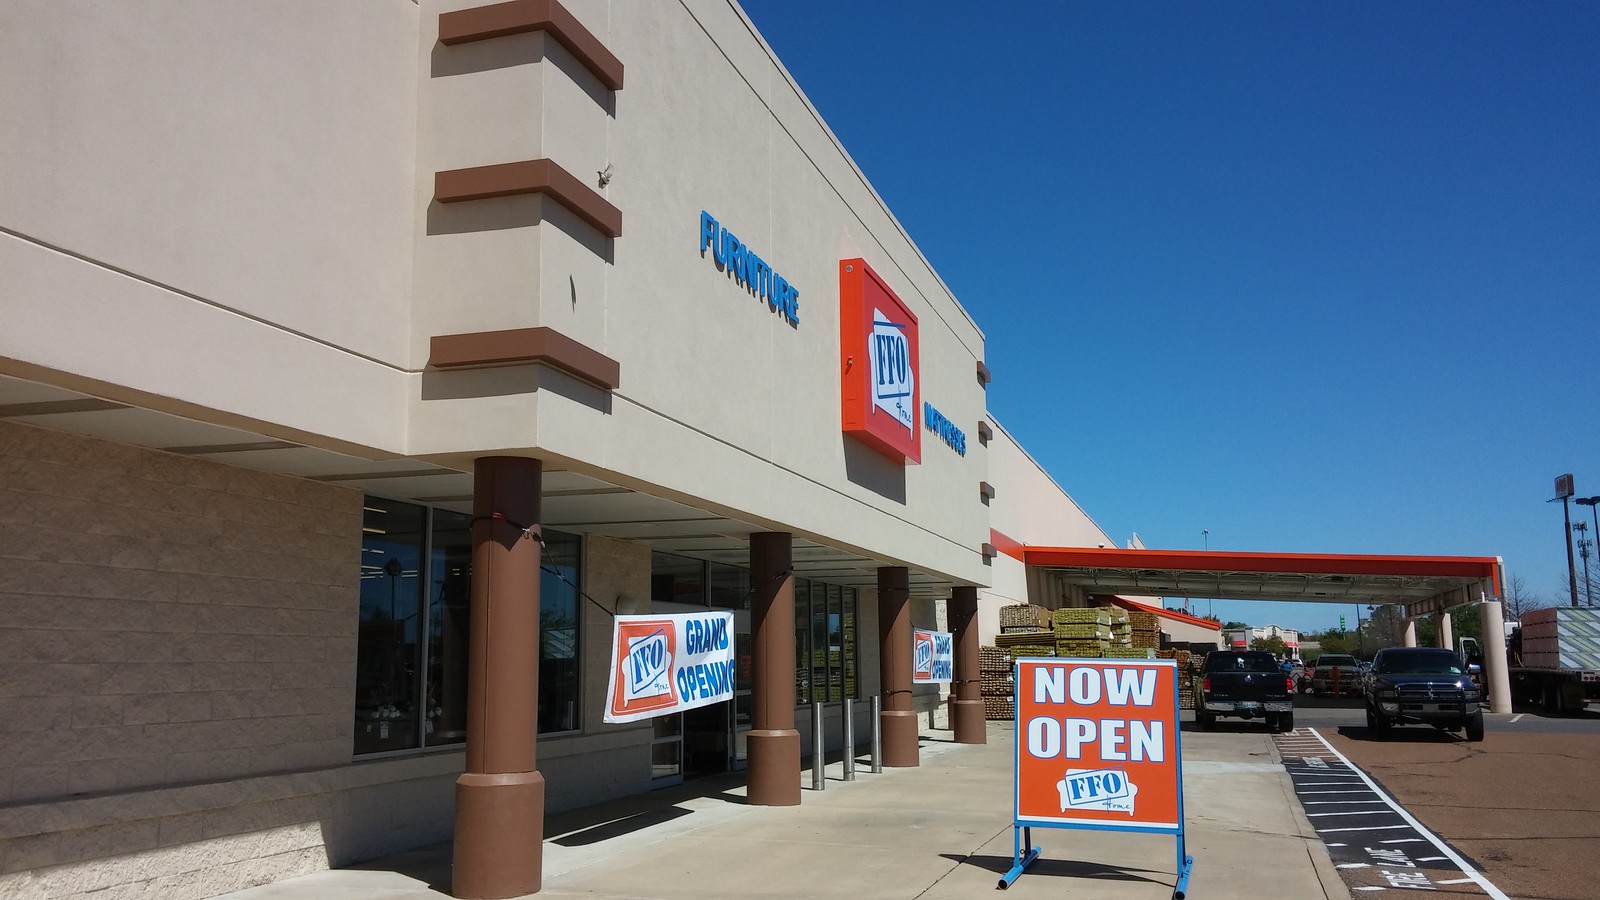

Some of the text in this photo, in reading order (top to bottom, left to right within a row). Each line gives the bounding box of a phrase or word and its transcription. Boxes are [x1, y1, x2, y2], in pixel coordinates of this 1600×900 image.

[700, 209, 800, 325] FURNITURE
[875, 333, 907, 386] FFO
[685, 617, 729, 656] GRAND
[632, 638, 664, 685] FFO
[1033, 666, 1158, 707] NOW
[1027, 716, 1165, 763] OPEN
[1069, 772, 1122, 801] FFO
[1102, 795, 1131, 812] Home
